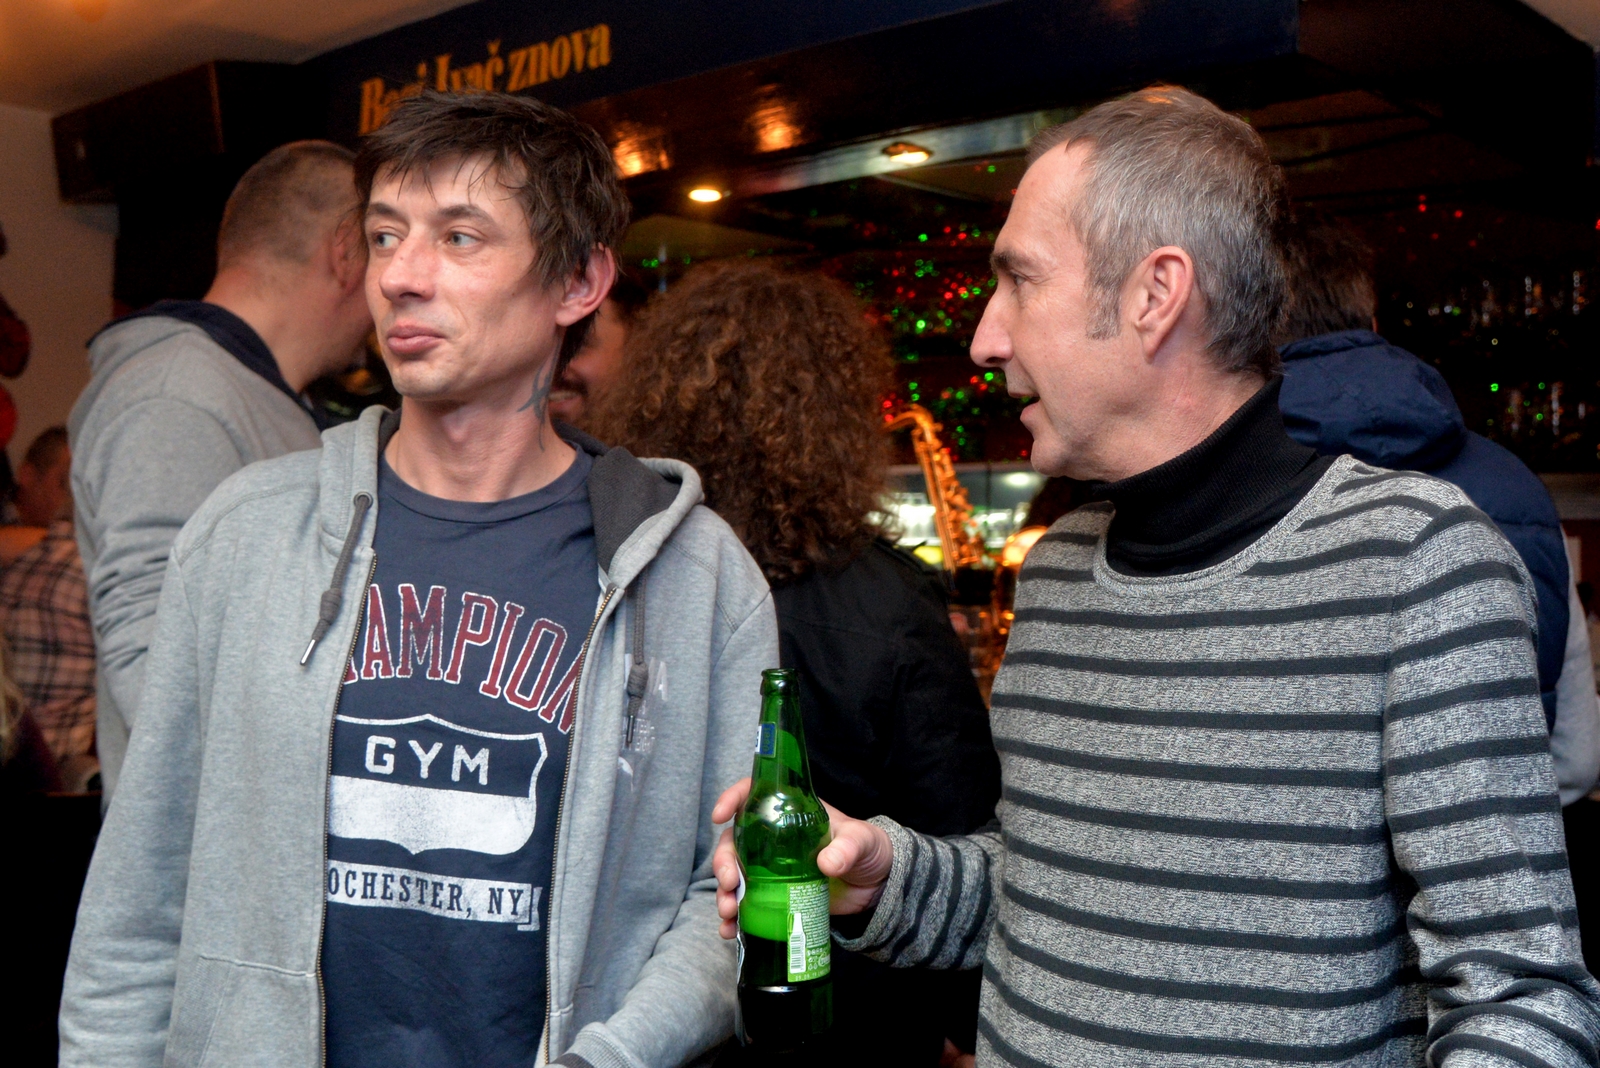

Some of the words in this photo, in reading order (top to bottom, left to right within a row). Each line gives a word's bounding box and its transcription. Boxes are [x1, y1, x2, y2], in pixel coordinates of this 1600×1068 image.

[507, 23, 612, 92] znova
[364, 735, 490, 786] GYM
[487, 886, 525, 917] NY
